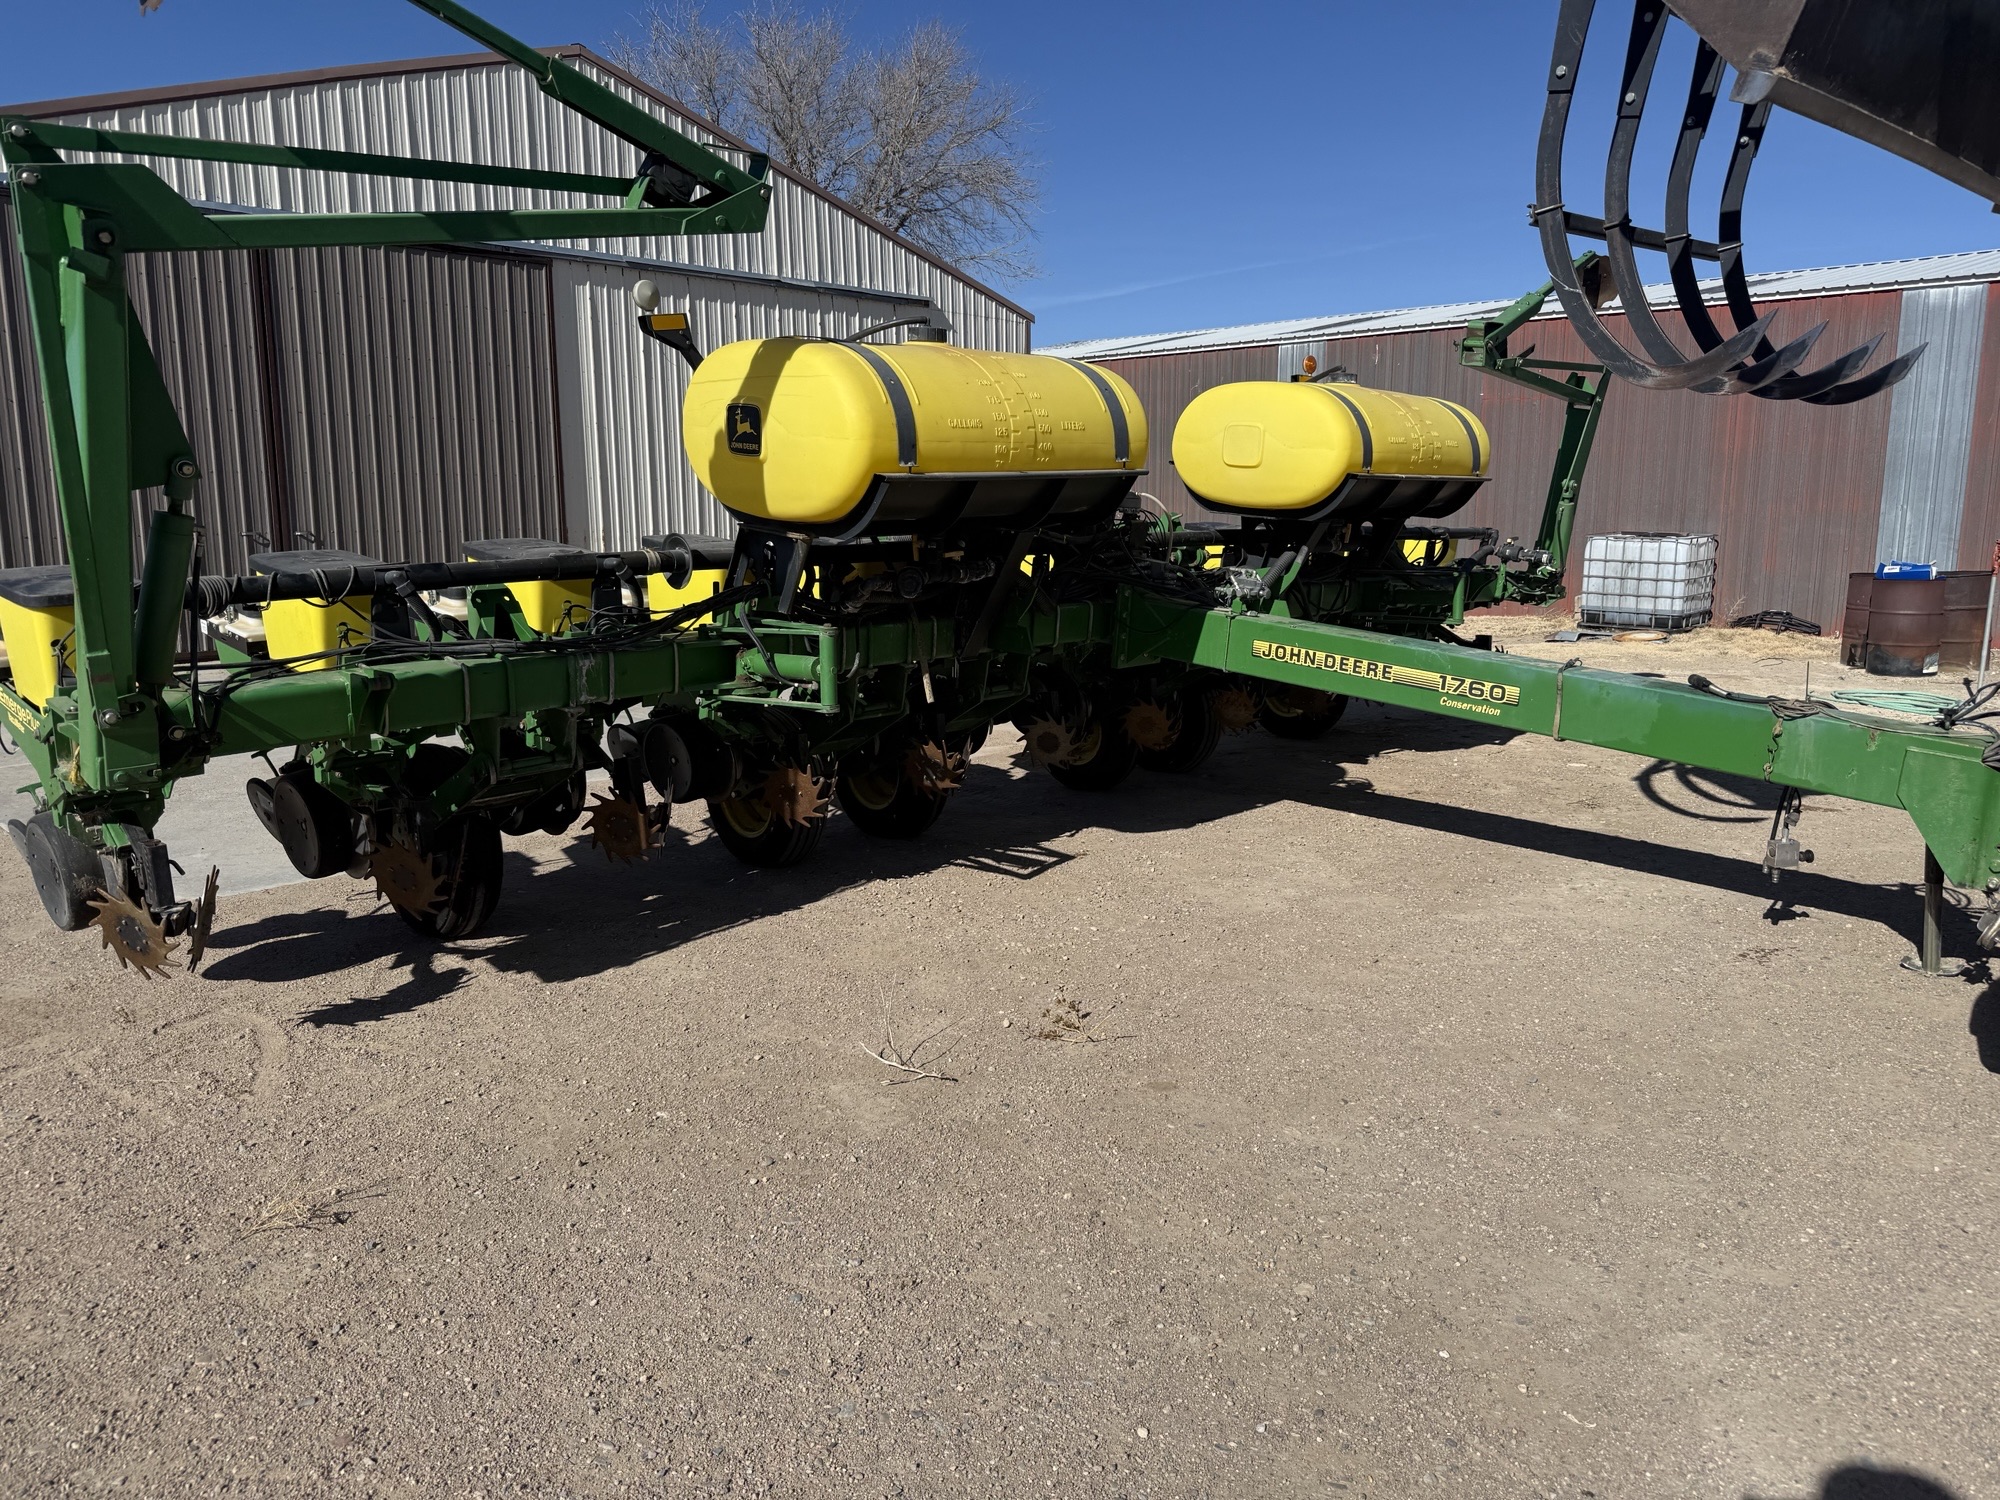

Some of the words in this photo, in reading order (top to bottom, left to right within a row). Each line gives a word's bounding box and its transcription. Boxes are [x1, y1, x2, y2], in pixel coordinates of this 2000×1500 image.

[993, 412, 1006, 421] 150
[948, 418, 983, 429] GALLONS
[1061, 421, 1085, 430] LITERS
[995, 428, 1008, 437] 125
[731, 441, 743, 449] JOHN
[995, 445, 1007, 453] 100
[1261, 643, 1317, 667] JOHN
[1323, 653, 1394, 681] DEERE
[1438, 674, 1507, 702] 1760
[1440, 696, 1501, 717] Conservation
